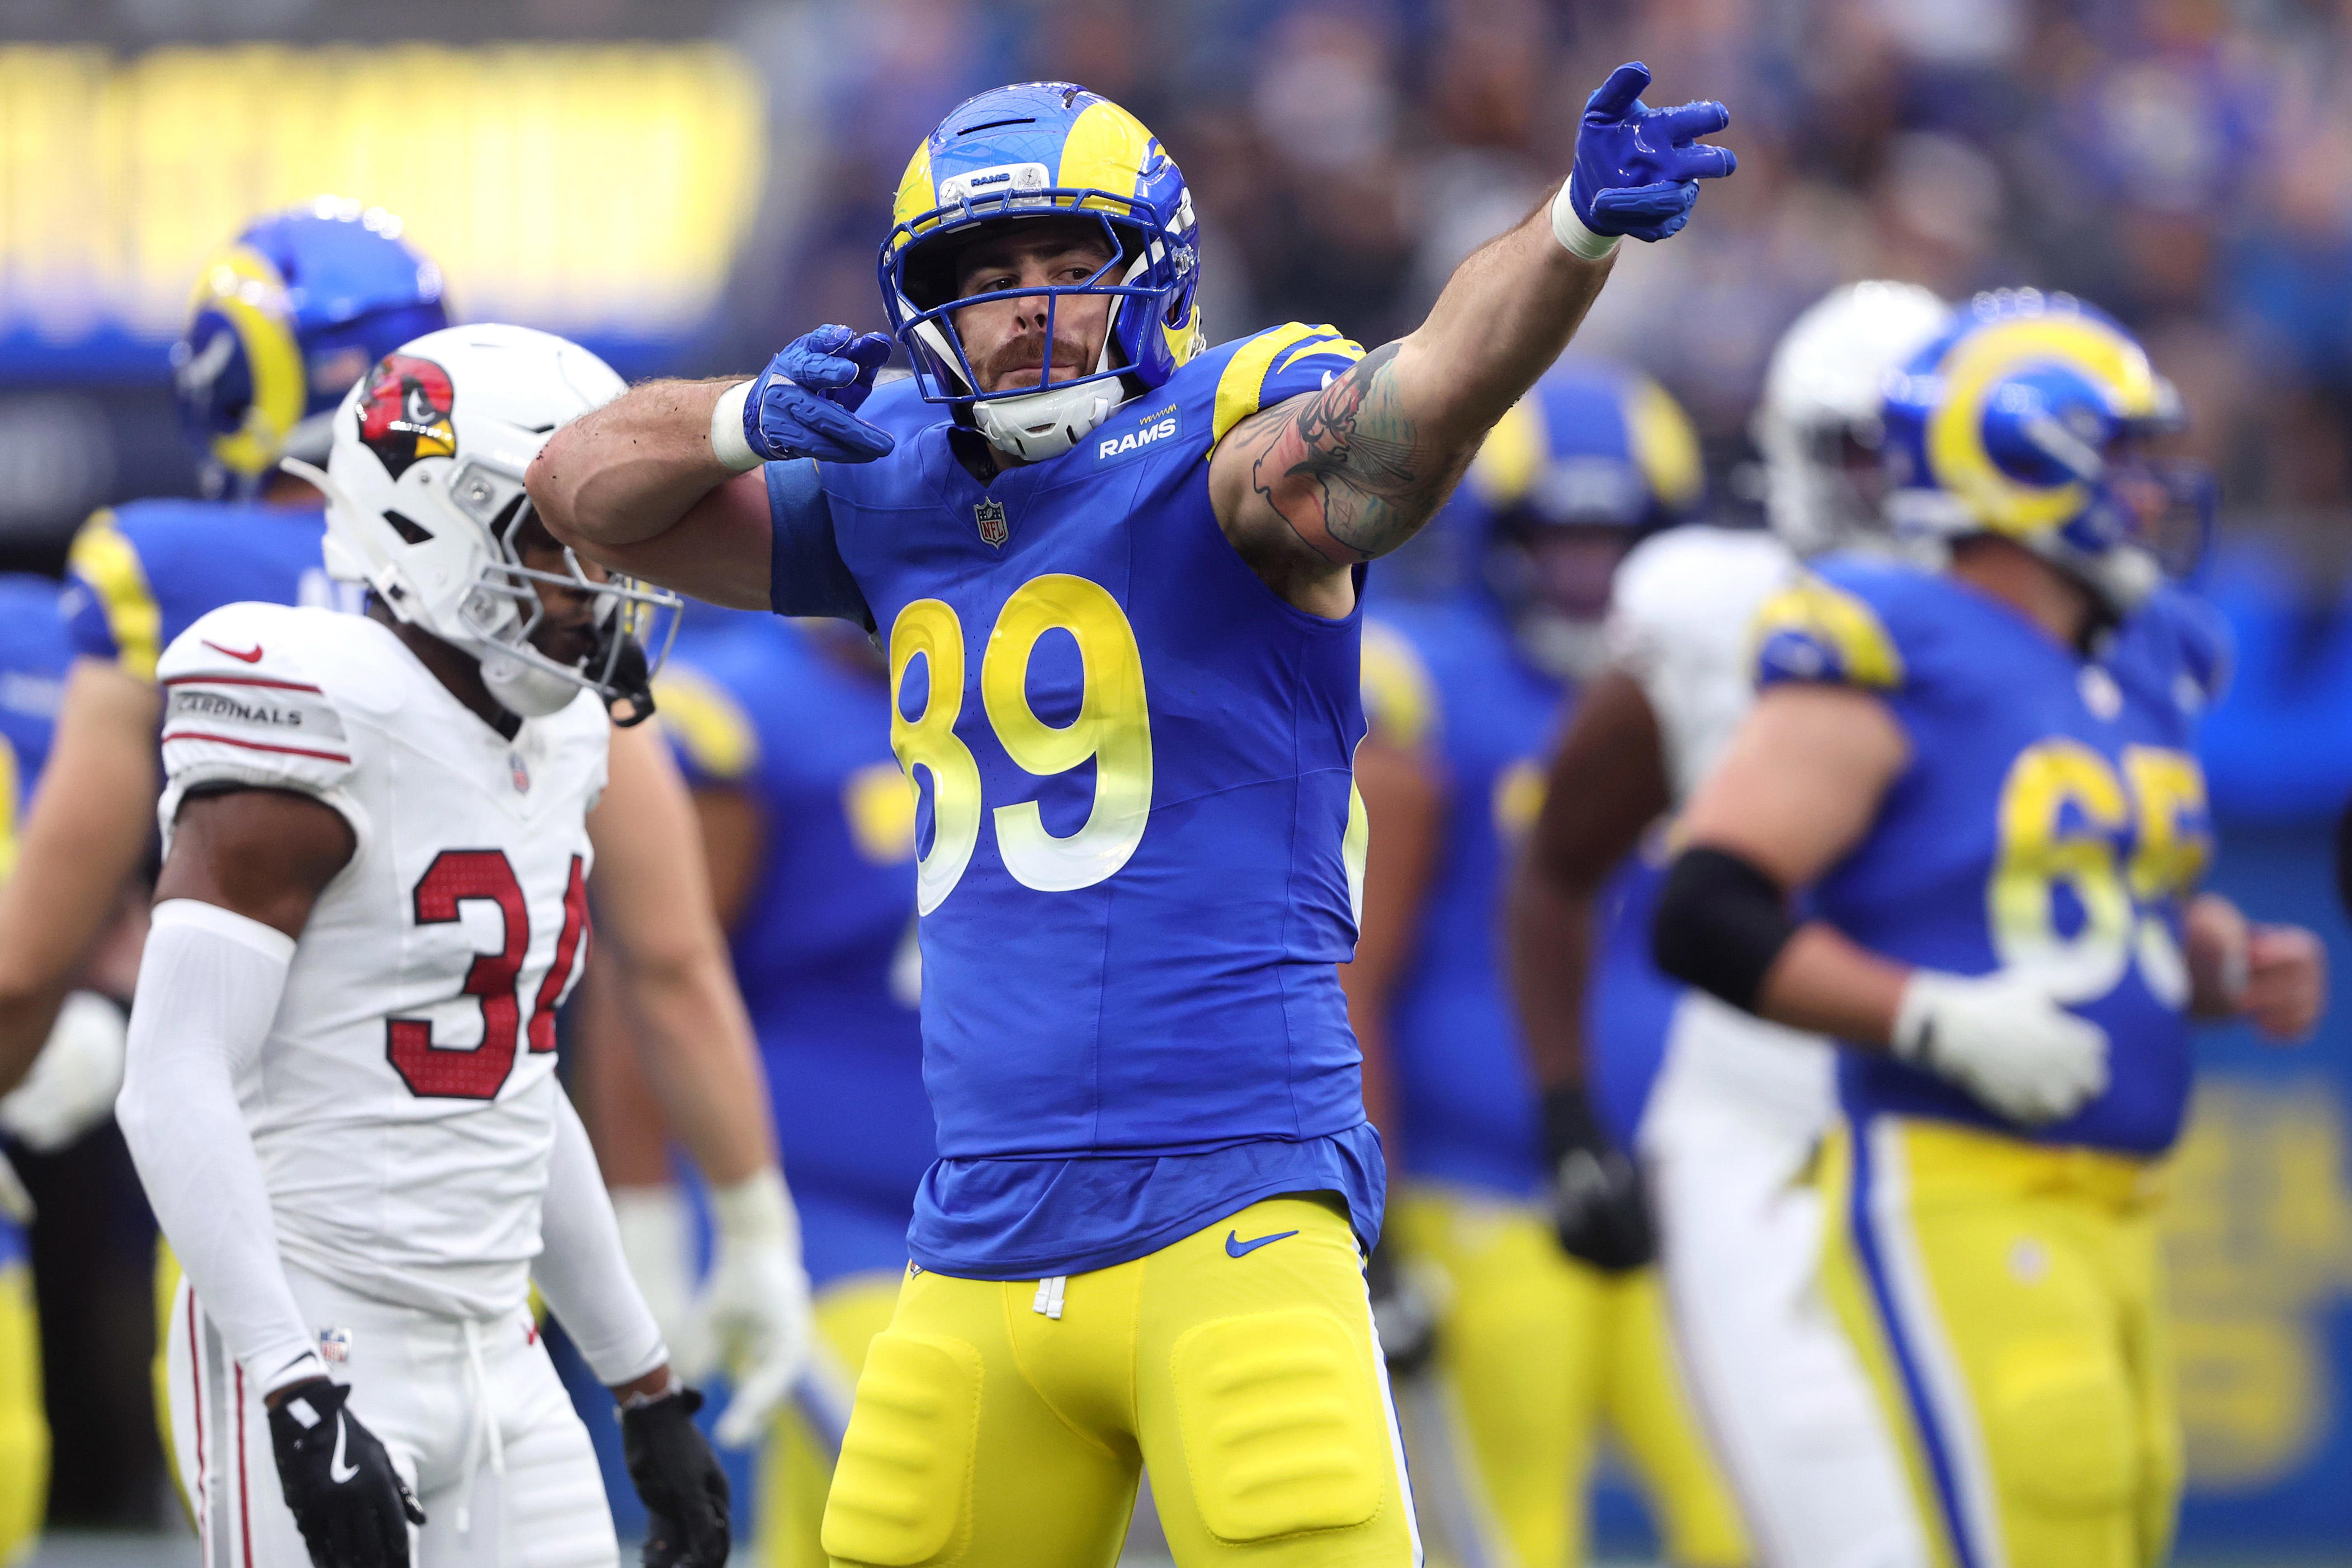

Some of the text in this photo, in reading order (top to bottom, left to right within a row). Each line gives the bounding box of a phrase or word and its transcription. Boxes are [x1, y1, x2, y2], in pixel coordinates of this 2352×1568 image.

[971, 173, 1010, 187] RAMS
[1099, 418, 1176, 460] RAMS
[983, 521, 1004, 540] NFL
[890, 573, 1153, 917] 89
[1992, 743, 2213, 1008] 65
